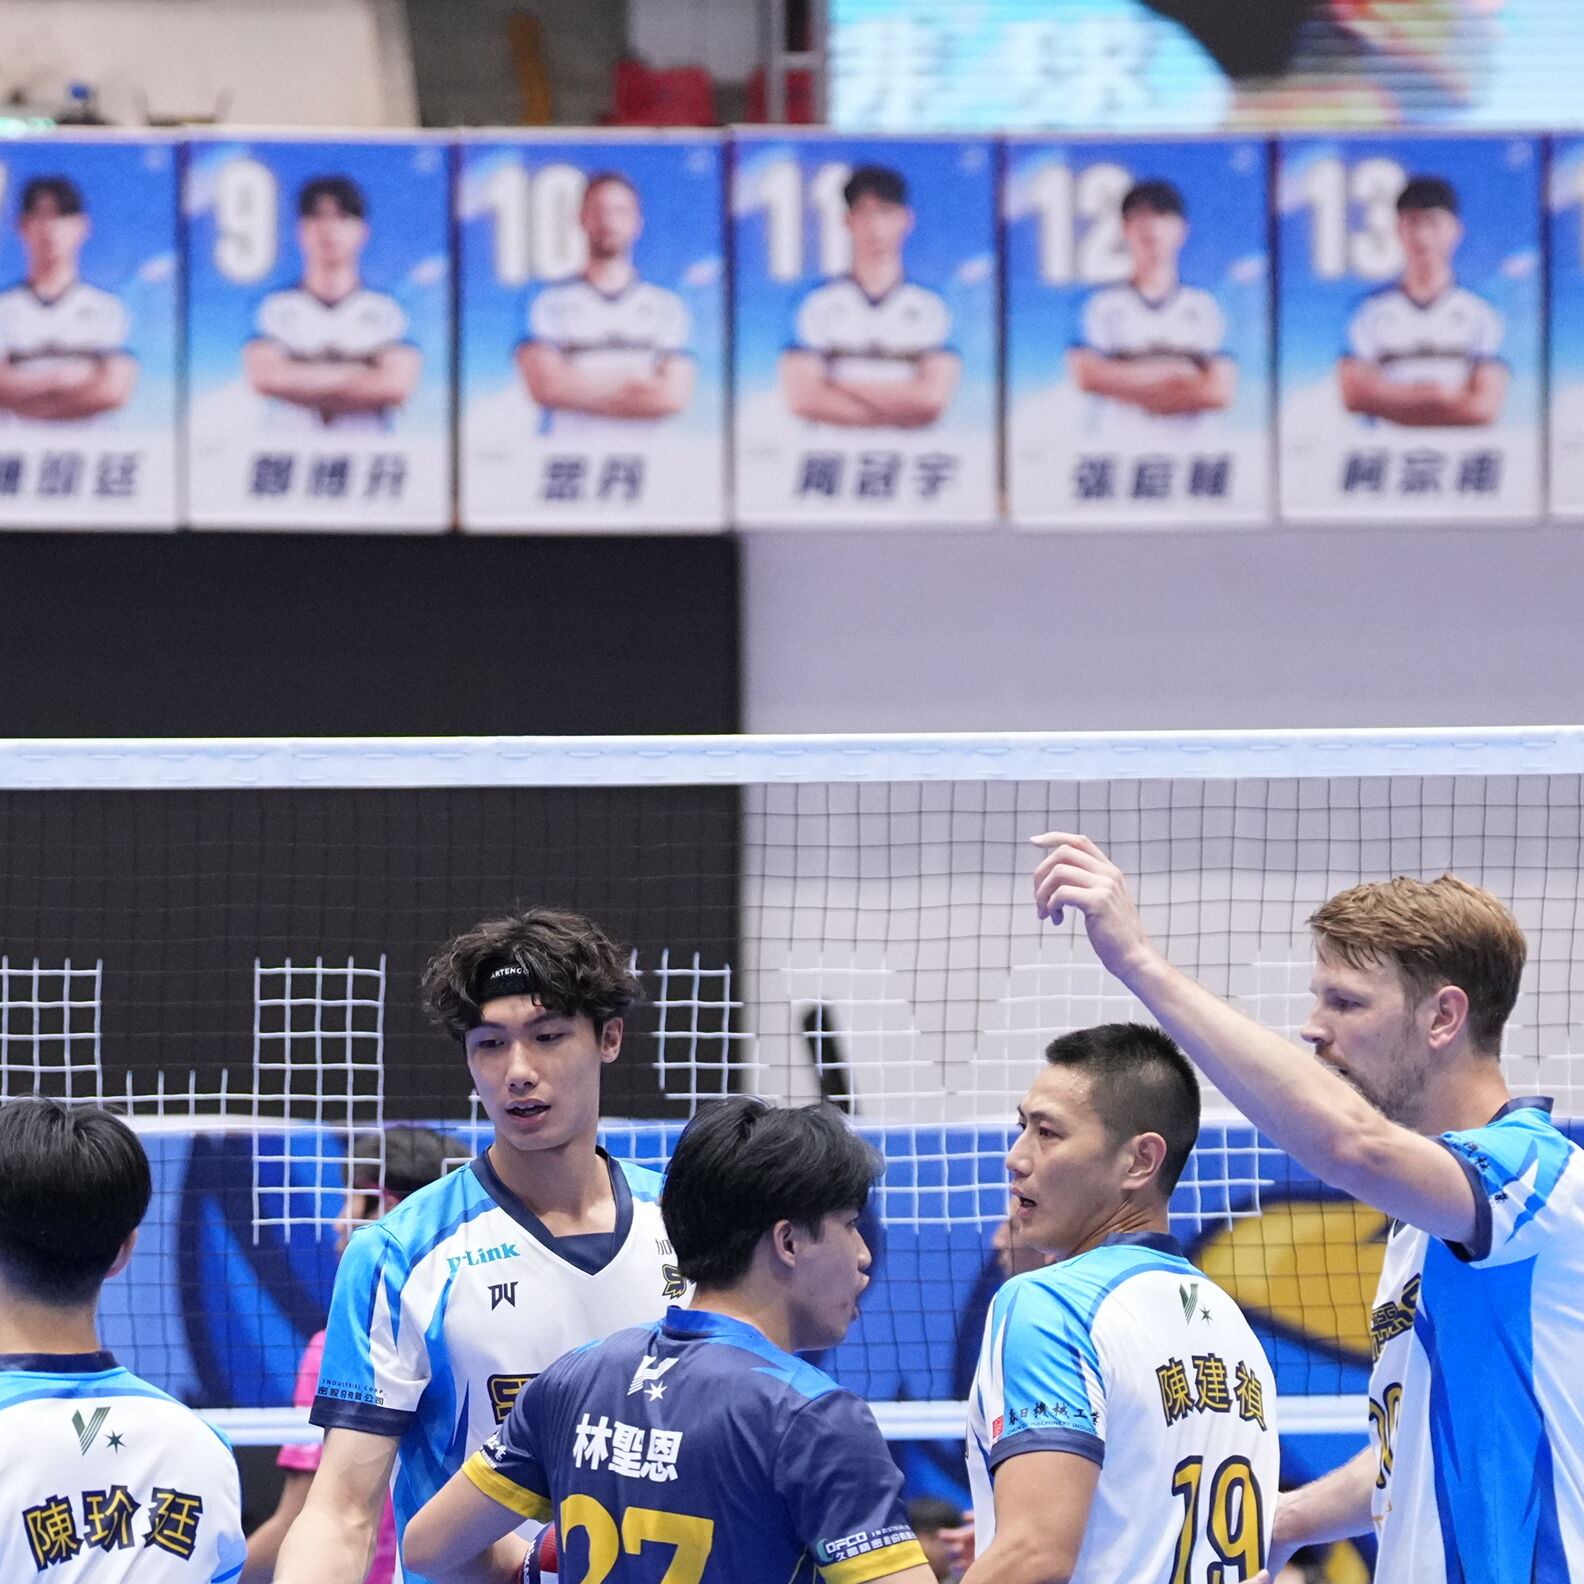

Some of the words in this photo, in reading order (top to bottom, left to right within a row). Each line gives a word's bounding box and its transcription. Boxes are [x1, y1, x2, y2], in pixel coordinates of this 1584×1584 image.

[215, 158, 279, 284] 9
[490, 162, 587, 287] 10
[761, 160, 854, 283] 11
[1028, 162, 1133, 287] 12
[1303, 157, 1407, 281] 13
[572, 1413, 684, 1482] 林聖恩
[1156, 1353, 1268, 1431] 陳建禎
[22, 1485, 203, 1572] 陳玠廷
